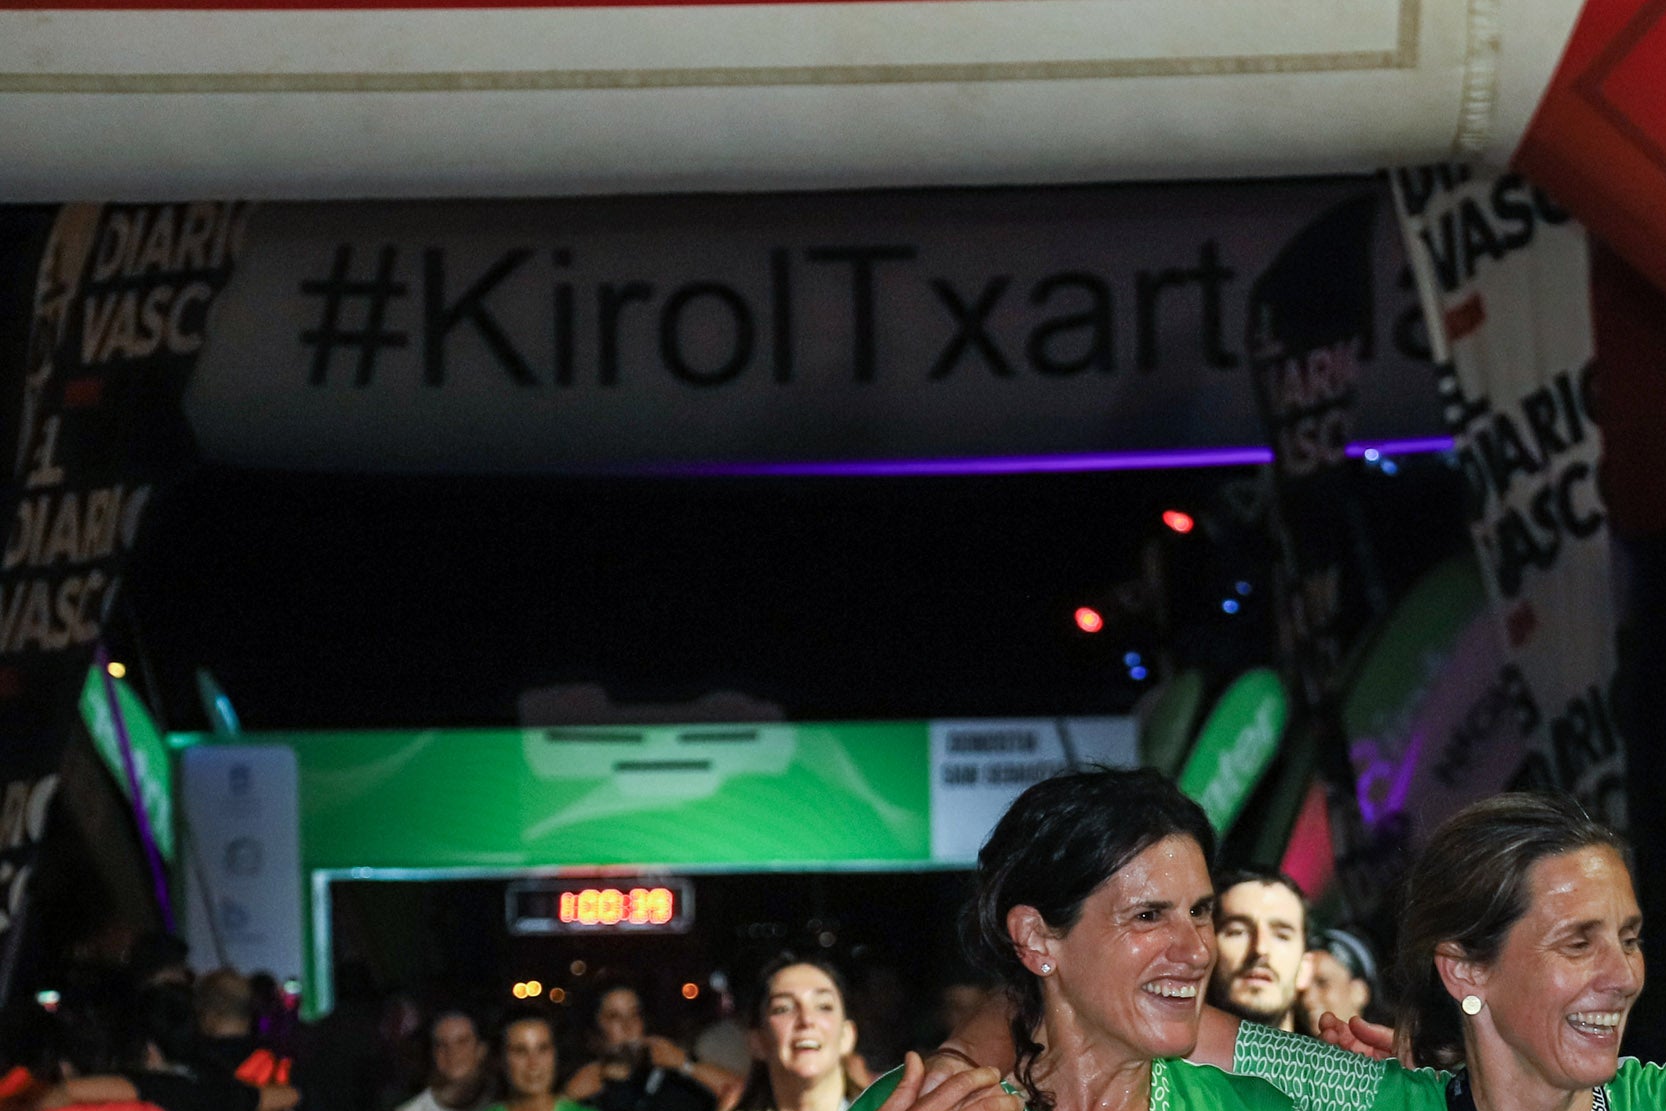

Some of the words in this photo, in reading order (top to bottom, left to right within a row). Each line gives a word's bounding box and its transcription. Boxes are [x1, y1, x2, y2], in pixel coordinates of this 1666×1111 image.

[94, 199, 248, 283] DIARI
[80, 280, 213, 366] VASC
[300, 240, 1436, 390] #KirolTxarta
